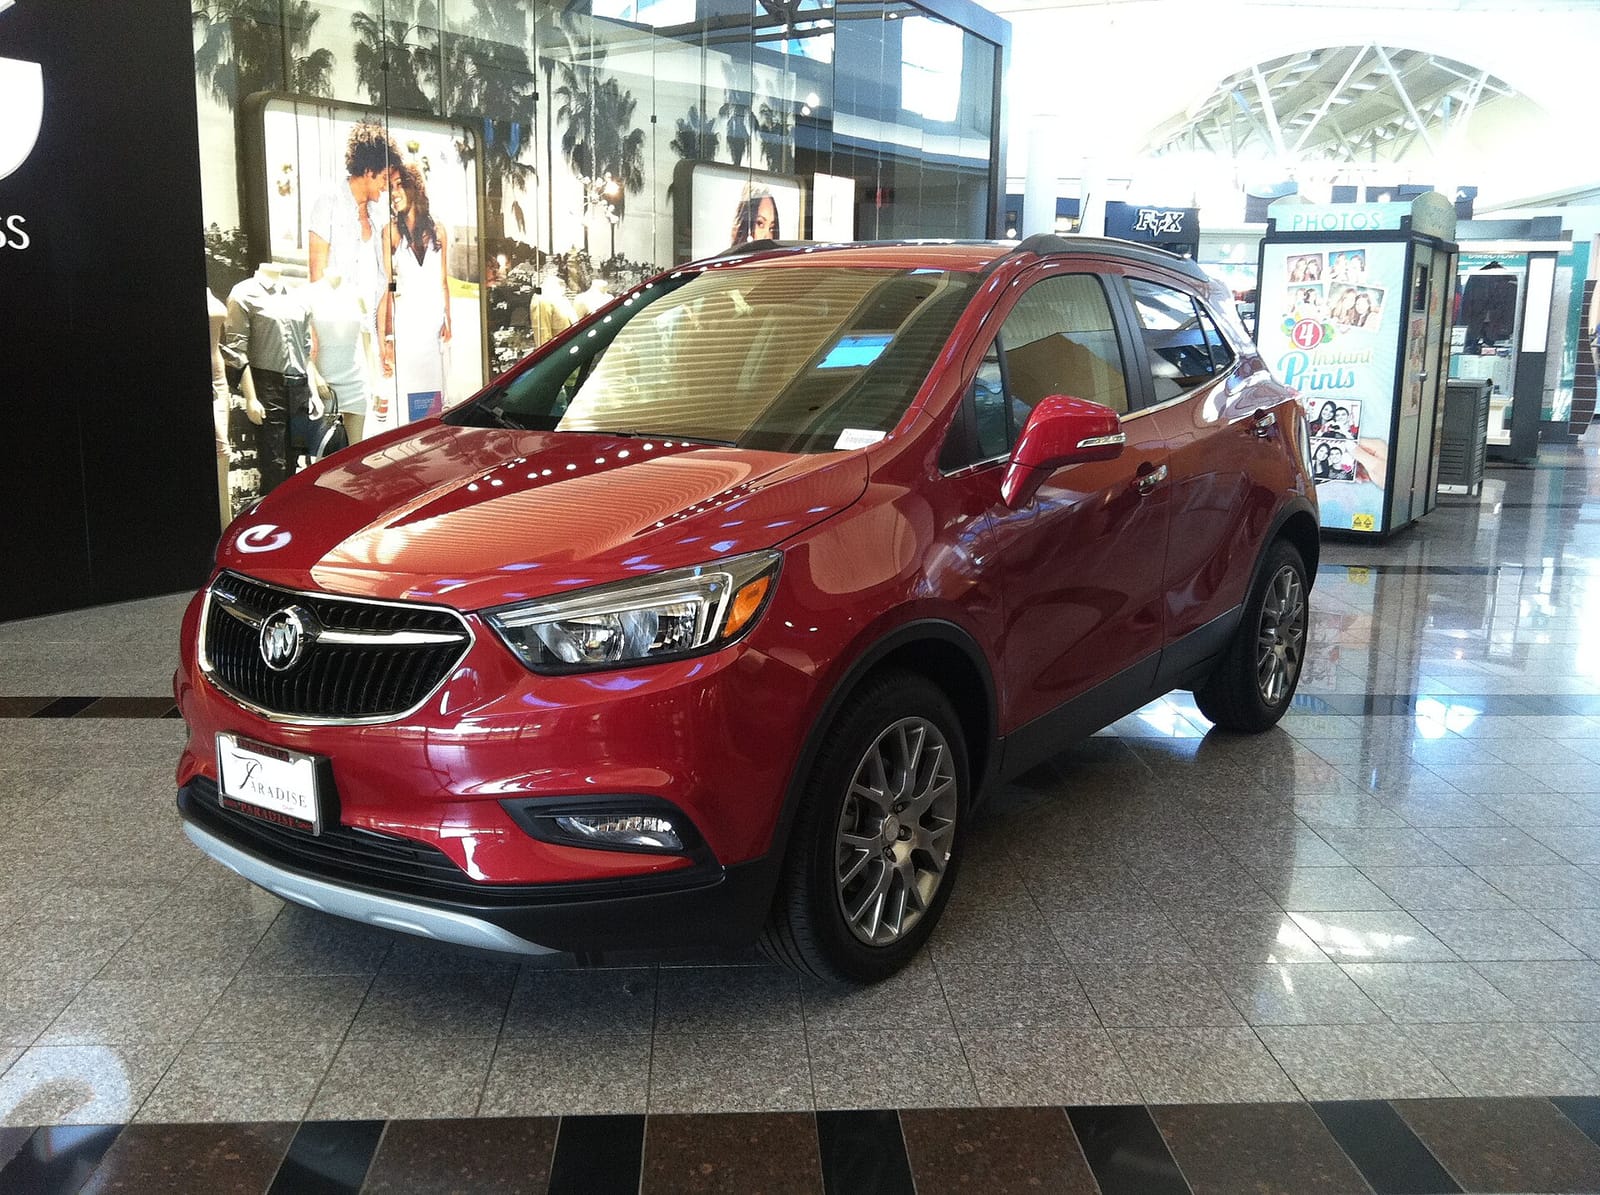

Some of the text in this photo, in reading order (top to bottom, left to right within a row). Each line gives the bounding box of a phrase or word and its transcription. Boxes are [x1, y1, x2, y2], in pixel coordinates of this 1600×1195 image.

[1292, 212, 1381, 232] PHOTOS
[1299, 323, 1314, 346] 4
[1312, 350, 1371, 365] Instant
[1277, 351, 1355, 391] Prints
[230, 752, 307, 808] PARADISE
